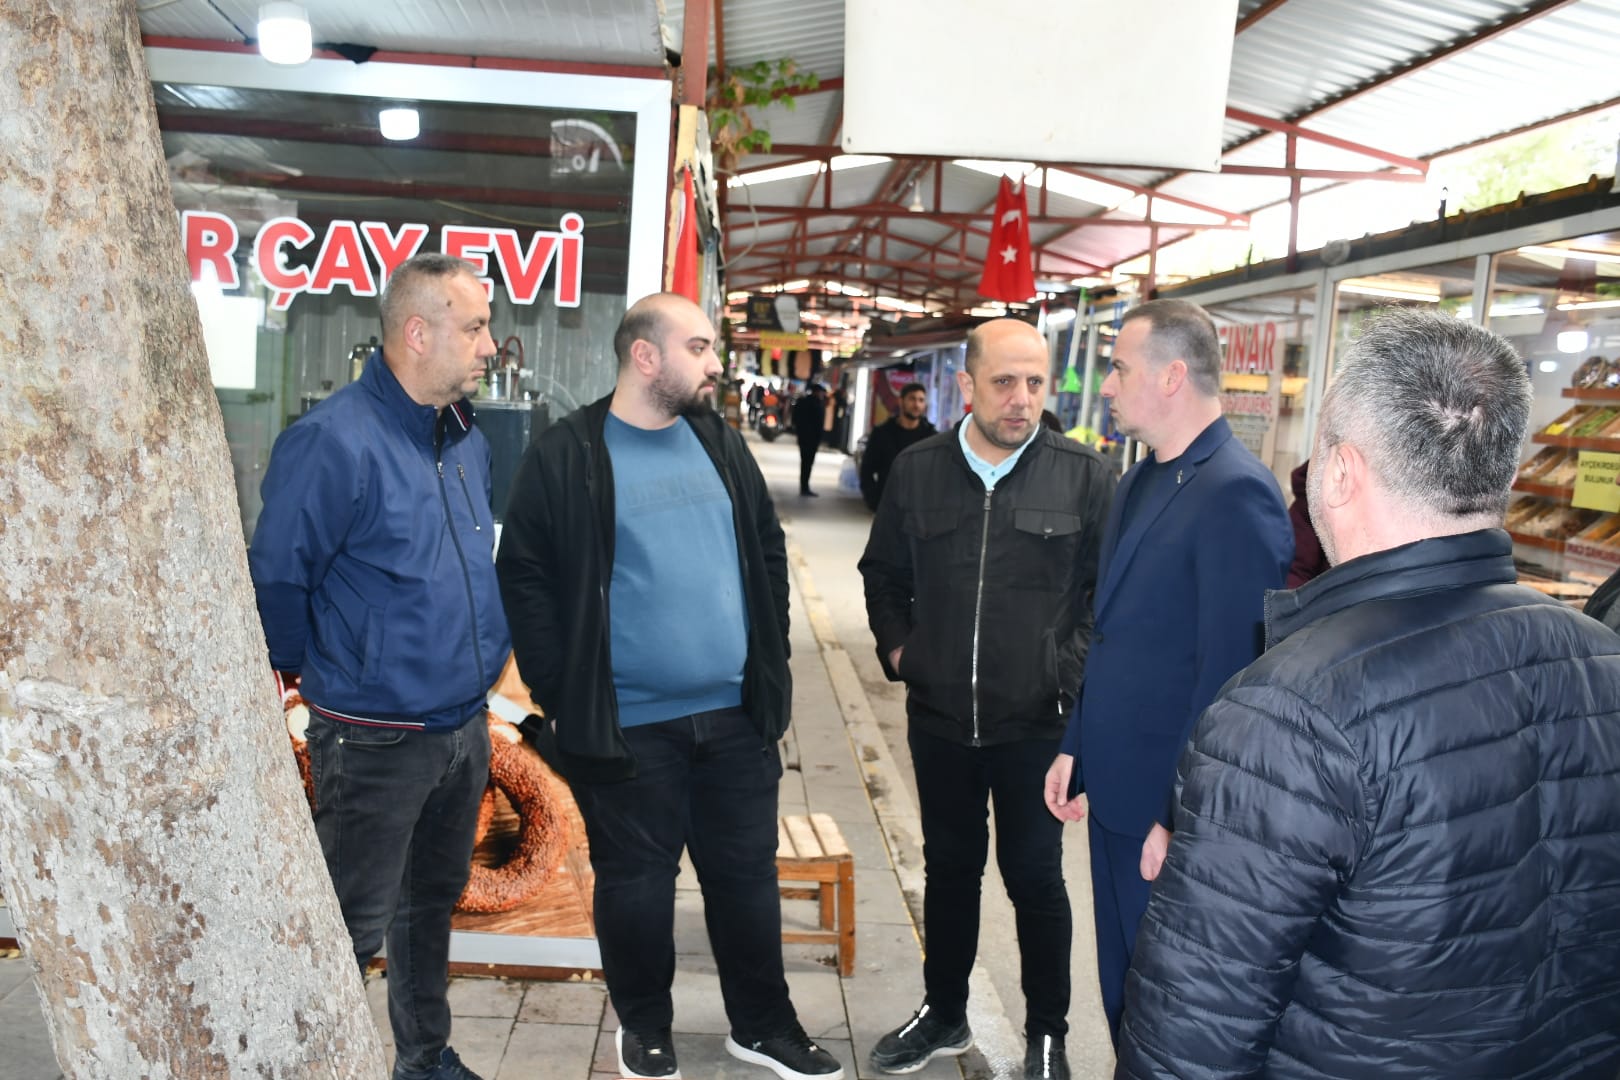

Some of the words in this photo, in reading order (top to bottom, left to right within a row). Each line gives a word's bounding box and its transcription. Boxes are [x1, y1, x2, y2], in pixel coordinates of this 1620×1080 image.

[178, 210, 240, 289] R
[254, 216, 429, 311] ÇAY
[441, 212, 584, 308] EVİ
